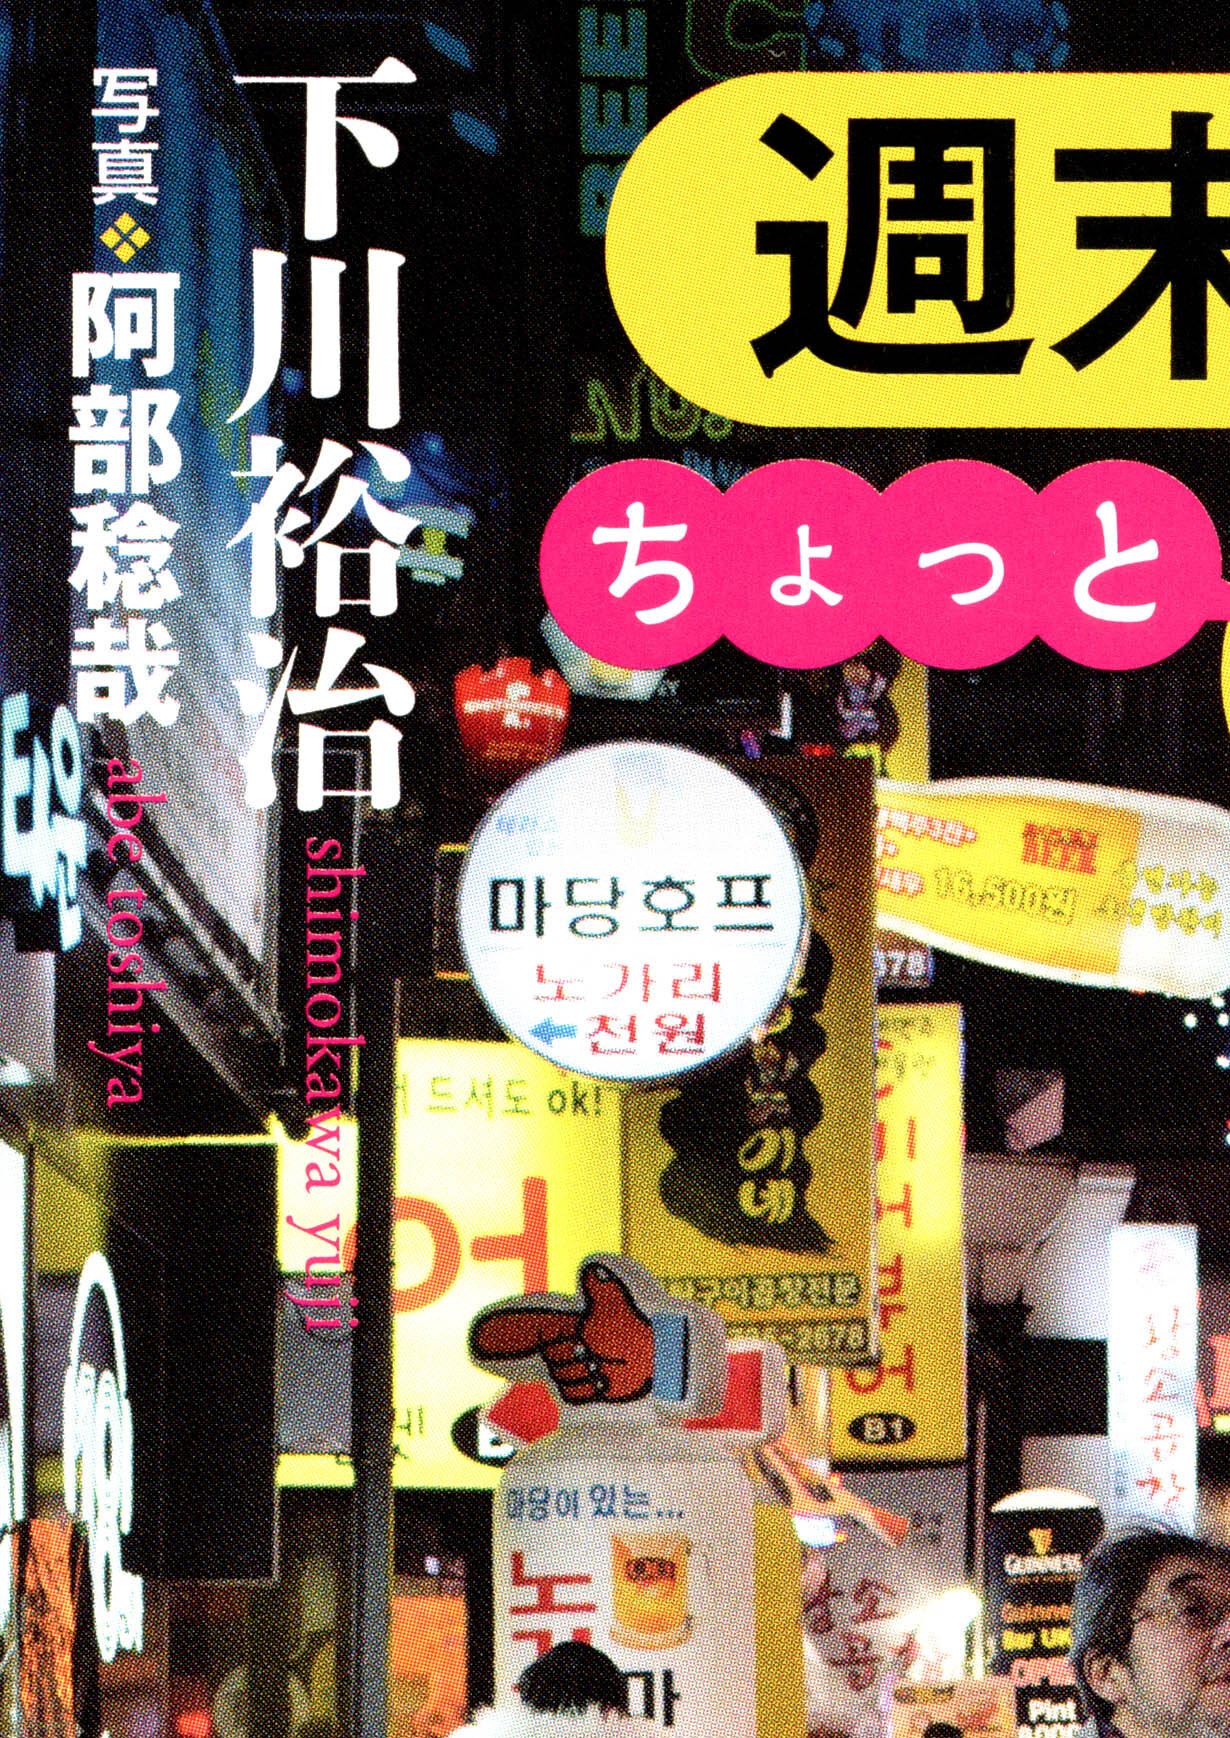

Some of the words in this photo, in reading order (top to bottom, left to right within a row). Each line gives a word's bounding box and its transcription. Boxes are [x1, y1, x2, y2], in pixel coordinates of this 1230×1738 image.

[488, 872, 775, 939] 마당호프
[532, 961, 722, 1004] 노가리
[547, 1081, 602, 1117] ok!
[863, 1416, 904, 1441] B1
